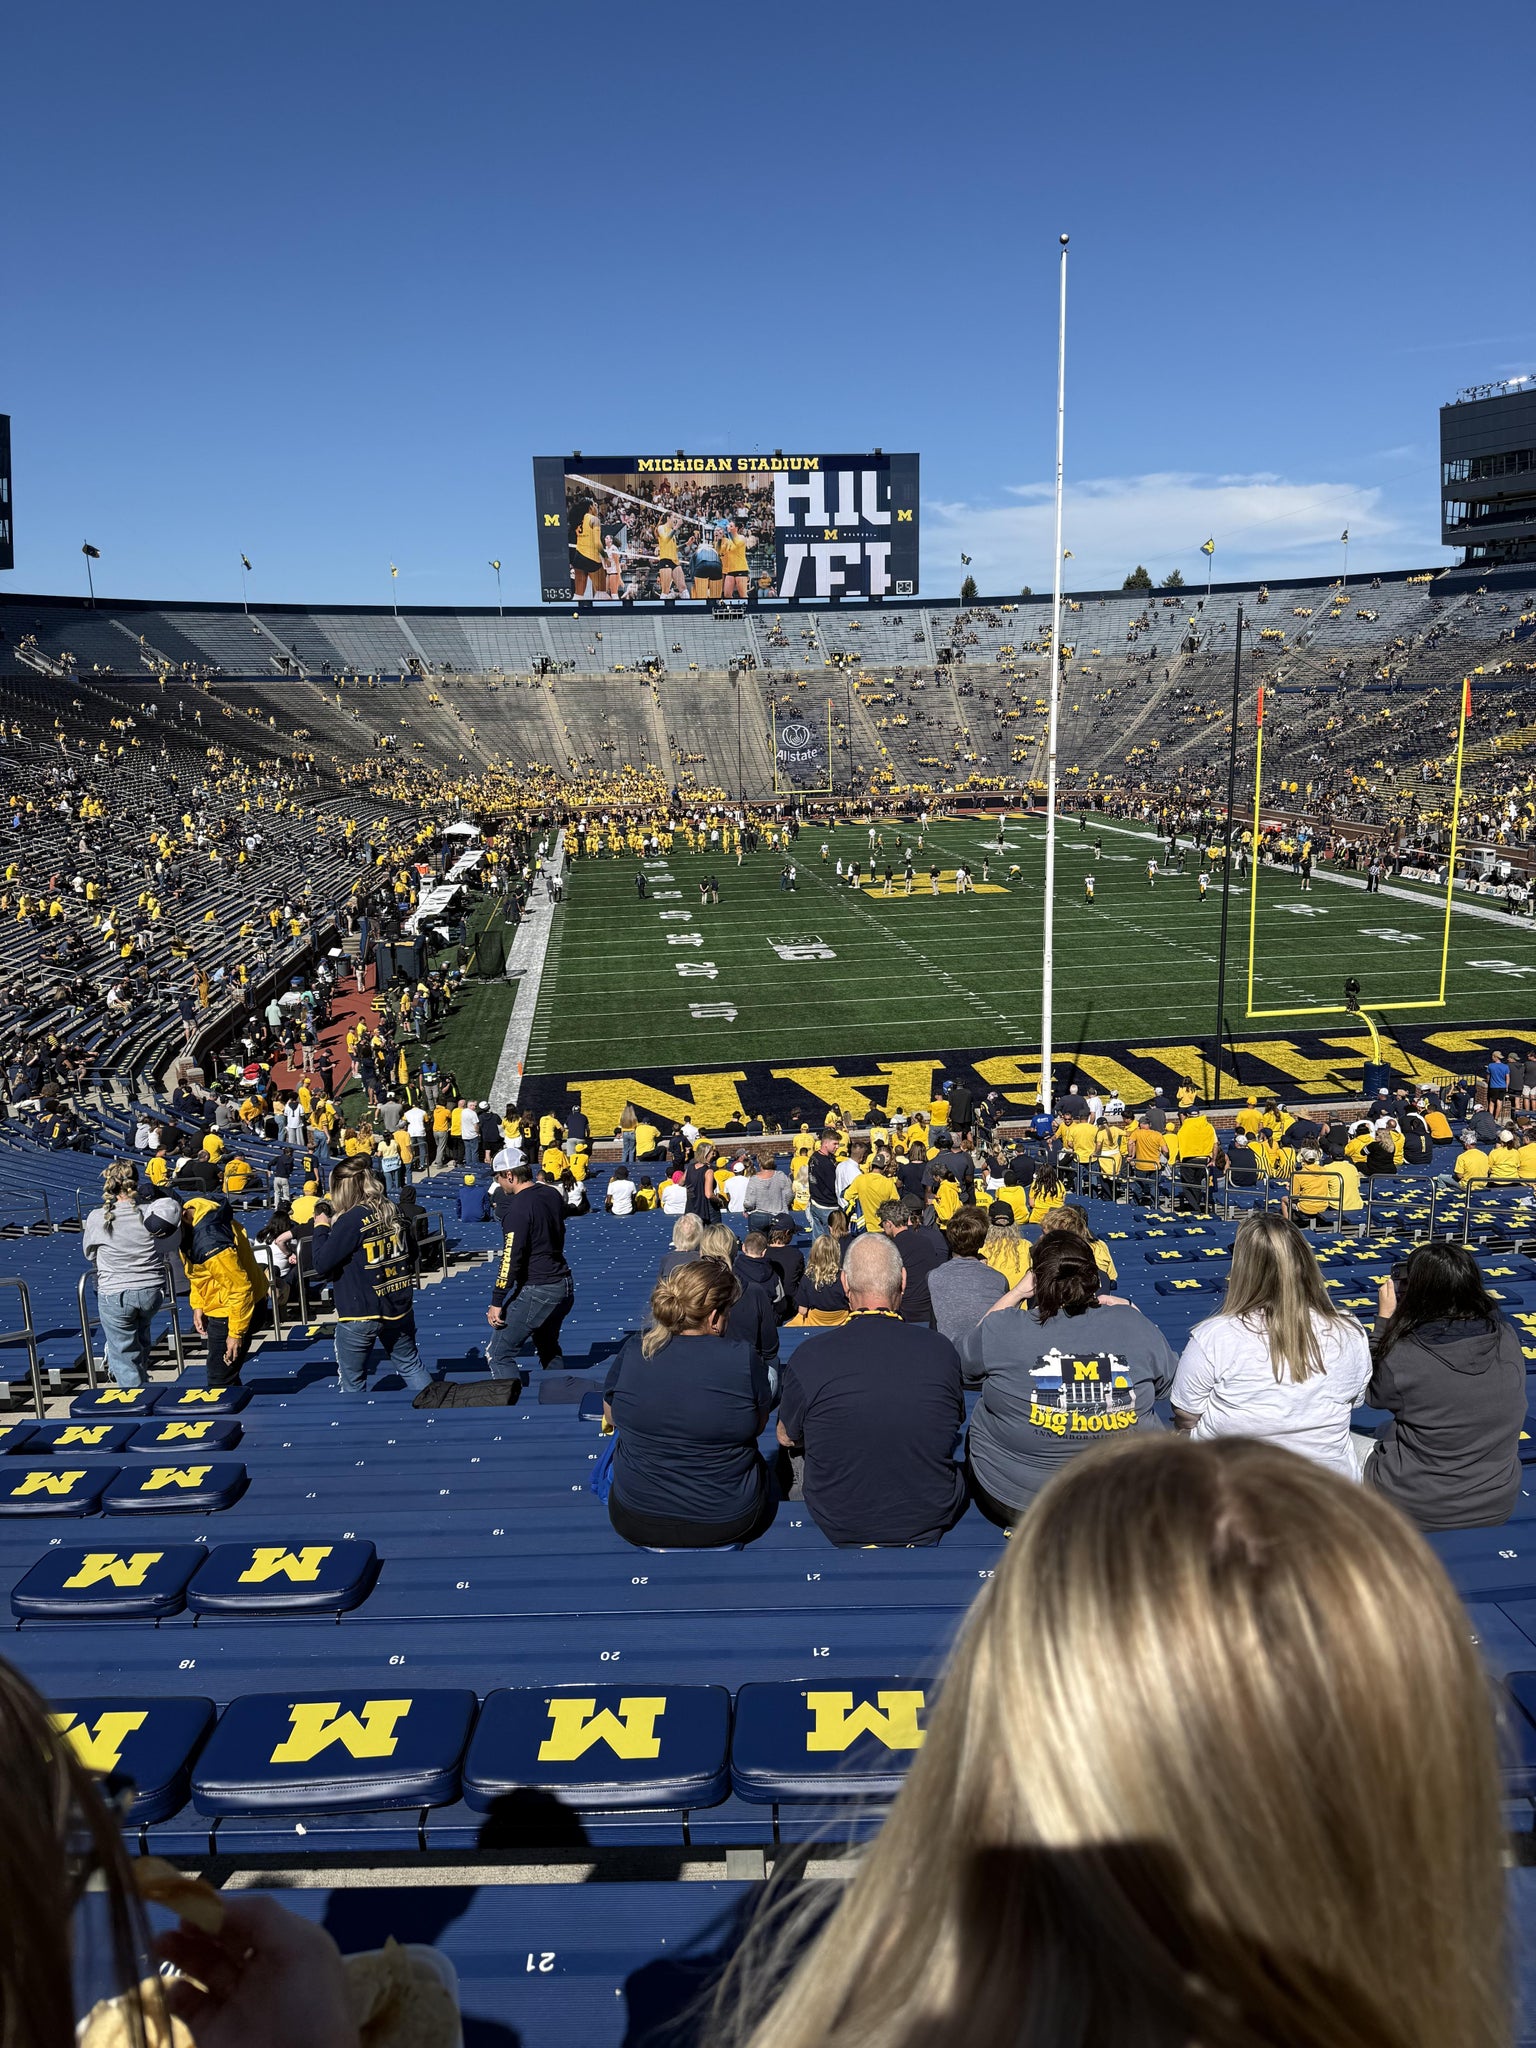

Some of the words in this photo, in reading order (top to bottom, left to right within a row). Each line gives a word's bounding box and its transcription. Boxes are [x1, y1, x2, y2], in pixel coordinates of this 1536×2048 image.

[638, 458, 732, 472] MICHIGAN
[737, 457, 819, 471] STADIUM
[544, 514, 560, 527] M
[897, 509, 912, 522] M
[824, 529, 838, 541] M
[776, 749, 818, 762] Allstate
[524, 1127, 532, 1138] 9
[1073, 1361, 1099, 1380] M
[95, 1389, 145, 1403] M
[178, 1388, 226, 1403] M
[1029, 1403, 1069, 1436] big
[1071, 1410, 1138, 1432] house
[53, 1426, 113, 1444] M
[156, 1421, 215, 1440] M
[10, 1470, 87, 1496] M
[140, 1466, 213, 1490] M
[790, 1520, 802, 1528] 21
[195, 1535, 207, 1543] 17
[1498, 1550, 1518, 1559] 25
[62, 1552, 165, 1588] M
[238, 1546, 333, 1583] M
[631, 1576, 649, 1585] 20
[806, 1573, 821, 1581] 21
[978, 1570, 995, 1578] 22
[456, 1581, 470, 1590] 19
[600, 1651, 621, 1661] 20
[813, 1647, 830, 1657] 21
[178, 1659, 196, 1670] 18
[388, 1655, 406, 1665] 19
[805, 1690, 927, 1752] M
[270, 1699, 413, 1763] M
[537, 1697, 667, 1761] M
[526, 1952, 556, 1973] 21
